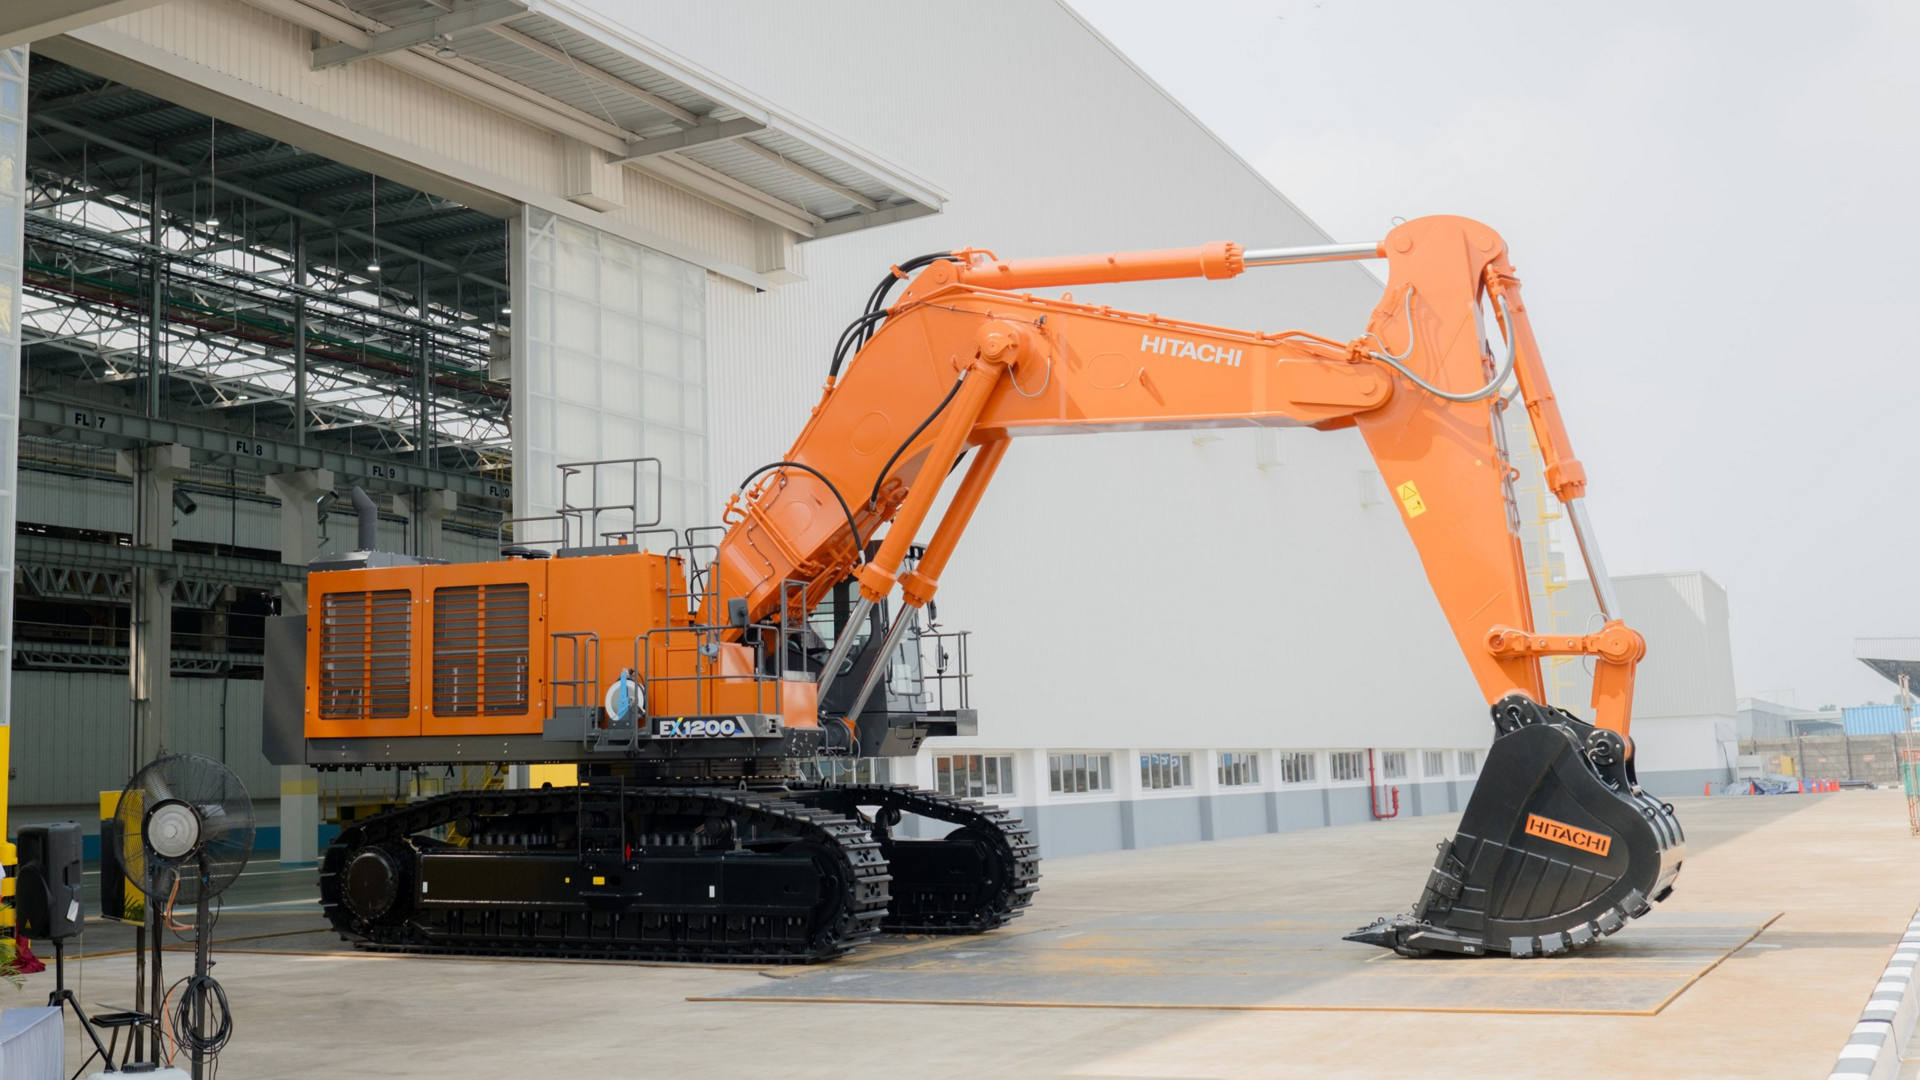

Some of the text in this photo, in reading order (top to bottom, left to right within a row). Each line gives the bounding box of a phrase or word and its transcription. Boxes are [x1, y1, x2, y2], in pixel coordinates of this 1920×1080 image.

[1140, 334, 1242, 367] HITACHI
[75, 413, 90, 428] FL
[236, 441, 249, 454] FL
[373, 466, 384, 477] FL
[489, 486, 499, 497] FL
[660, 718, 736, 737] EX1200
[1529, 818, 1607, 852] HITACHI
